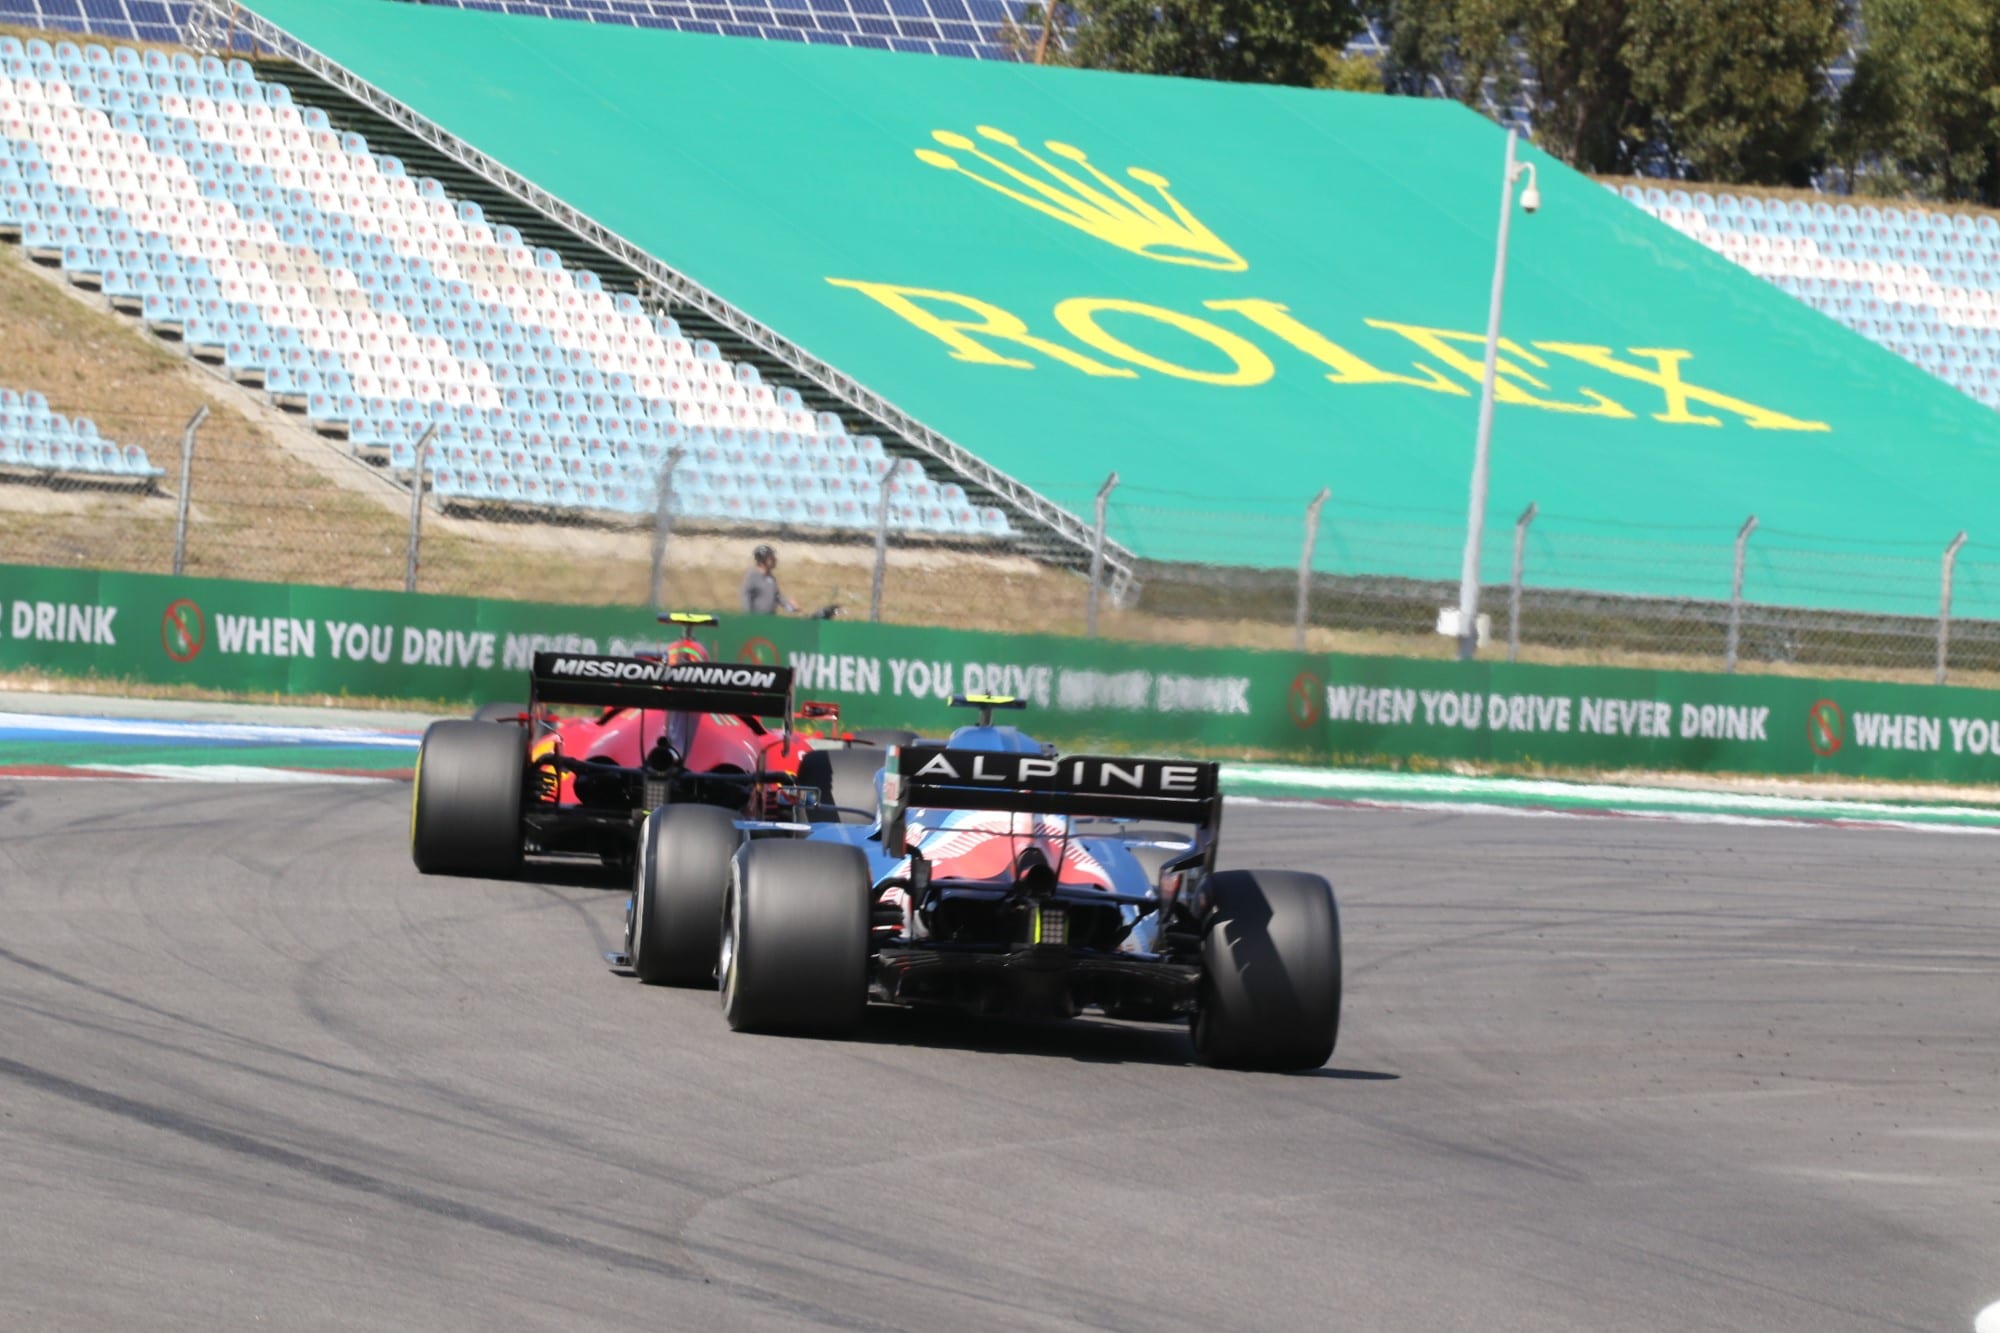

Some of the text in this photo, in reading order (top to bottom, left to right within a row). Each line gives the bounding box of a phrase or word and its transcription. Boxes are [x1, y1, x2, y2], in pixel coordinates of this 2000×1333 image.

[823, 277, 1831, 432] ROLEX
[12, 600, 118, 645] DRINK
[214, 613, 316, 658] WHEN
[325, 620, 394, 664] YOU
[402, 626, 496, 669] DRIVE
[552, 658, 777, 689] MISSION WINNOW
[789, 651, 881, 695] WHEN
[889, 659, 954, 698] YOU
[963, 662, 1053, 709] DRIVE
[1326, 685, 1769, 741] WHEN YOU DRIVE NEVER DRINK
[1852, 712, 1941, 752] WHEN
[914, 752, 1199, 791] ALPINE
